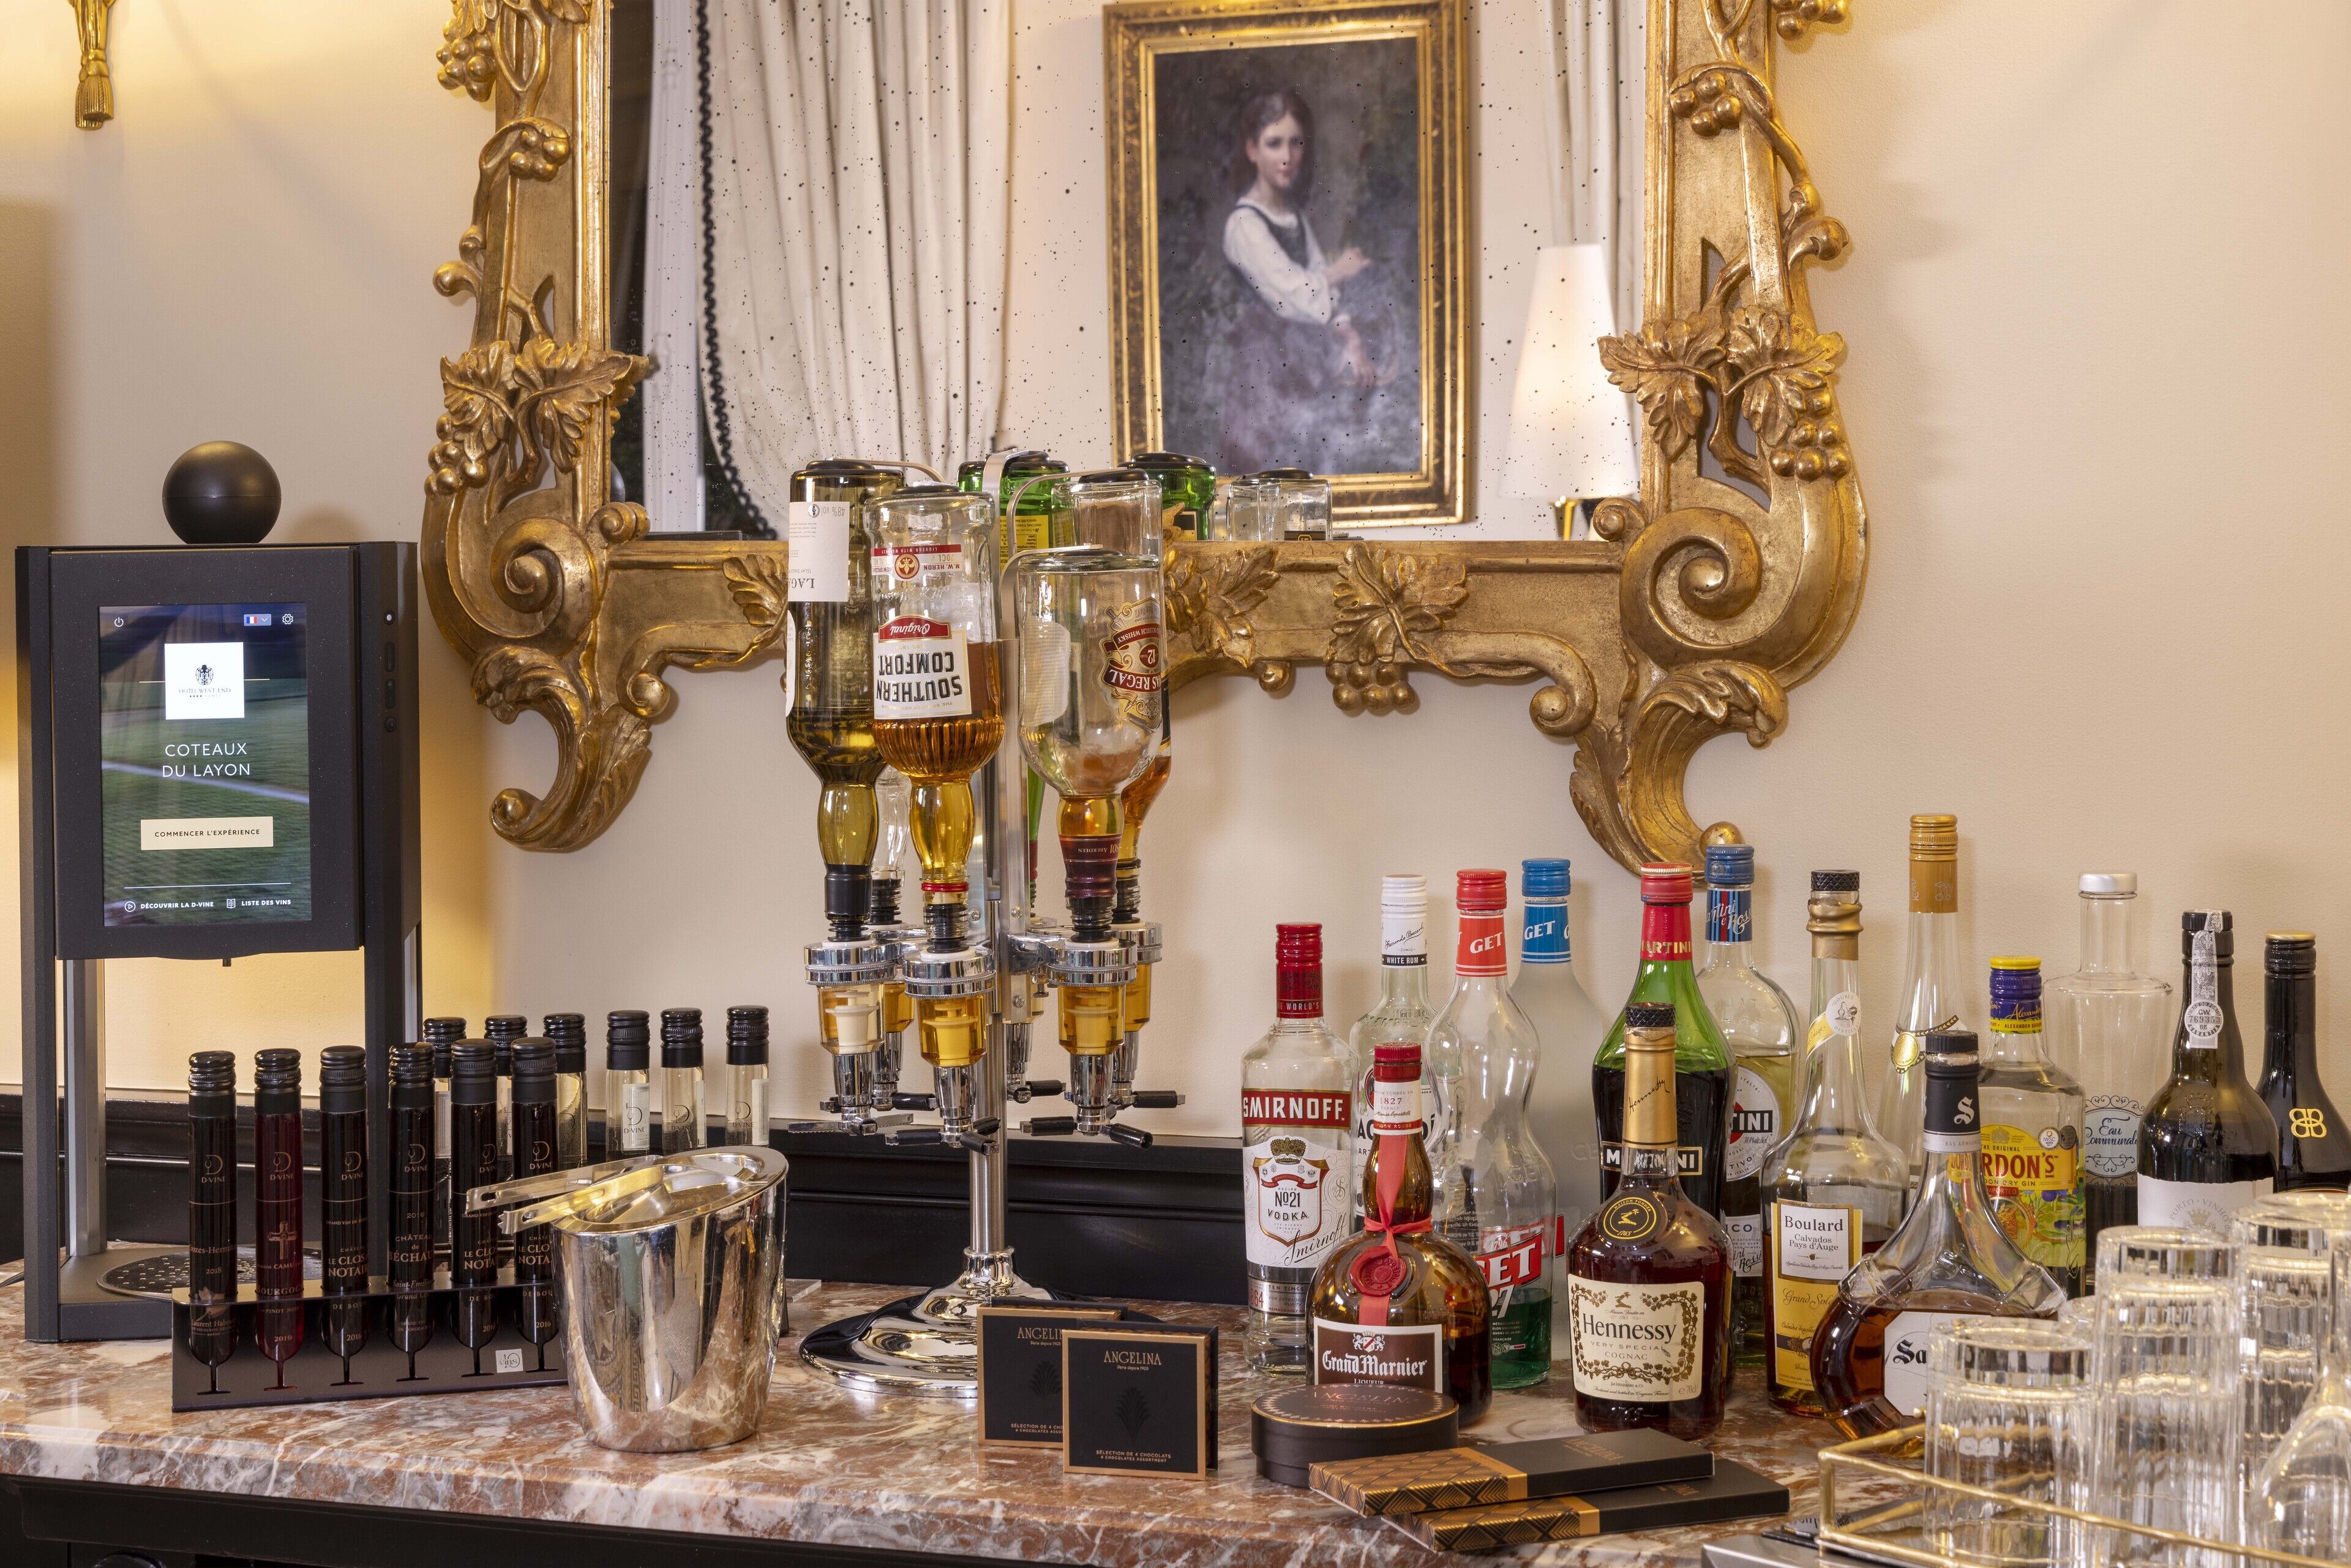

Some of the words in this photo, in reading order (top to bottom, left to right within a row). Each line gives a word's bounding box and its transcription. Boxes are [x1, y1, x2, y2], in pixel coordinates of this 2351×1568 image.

[821, 506, 830, 517] vol
[832, 506, 846, 517] 48%
[789, 578, 815, 588] LAG
[890, 622, 931, 636] Original
[1117, 629, 1141, 643] WHISKY
[1147, 649, 1155, 664] 12
[1109, 669, 1150, 690] REGAL
[876, 675, 963, 702] SOUTHERN
[165, 743, 247, 757] COTEAUX
[162, 765, 186, 778] DU
[193, 763, 250, 777] LAYON
[1524, 920, 1556, 940] GET
[1469, 931, 1502, 954] GET
[1286, 1002, 1319, 1010] WORLD'S
[2189, 1015, 2220, 1024] 769353
[2189, 1026, 2219, 1037] GARANTIA
[1629, 1076, 1670, 1116] Hennessy
[1243, 1097, 1343, 1120] SMIRNOFF
[1954, 1096, 1974, 1124] S
[2099, 1116, 2130, 1136] Eau
[1982, 1152, 2055, 1179] RDON'S
[1613, 1199, 1633, 1210] MAISON
[2169, 1198, 2194, 1220] PORTO
[2202, 1198, 2228, 1222] VINHO
[1267, 1209, 1309, 1221] VODKA
[1785, 1215, 1843, 1231] Boulard
[1281, 1212, 1347, 1266] Smirnoff
[1789, 1239, 1807, 1250] Pays
[1809, 1242, 1839, 1252] d'Auge
[1794, 1234, 1832, 1244] Calvados
[476, 1247, 495, 1257] CLO
[527, 1244, 550, 1253] CLO
[339, 1254, 366, 1265] CLOS
[464, 1259, 495, 1270] NOTA
[518, 1255, 551, 1265] NOTA
[1250, 1288, 1264, 1308] 864
[1782, 1288, 1810, 1305] Grand
[1018, 1327, 1063, 1340] ANGELIN
[1583, 1313, 1677, 1344] Hennessy
[1104, 1350, 1161, 1365] ANGELINA
[1605, 1351, 1648, 1360] COGNAC
[1892, 1338, 1927, 1365] Sa
[1322, 1349, 1359, 1374] Grand
[1358, 1354, 1427, 1376] Marnier
